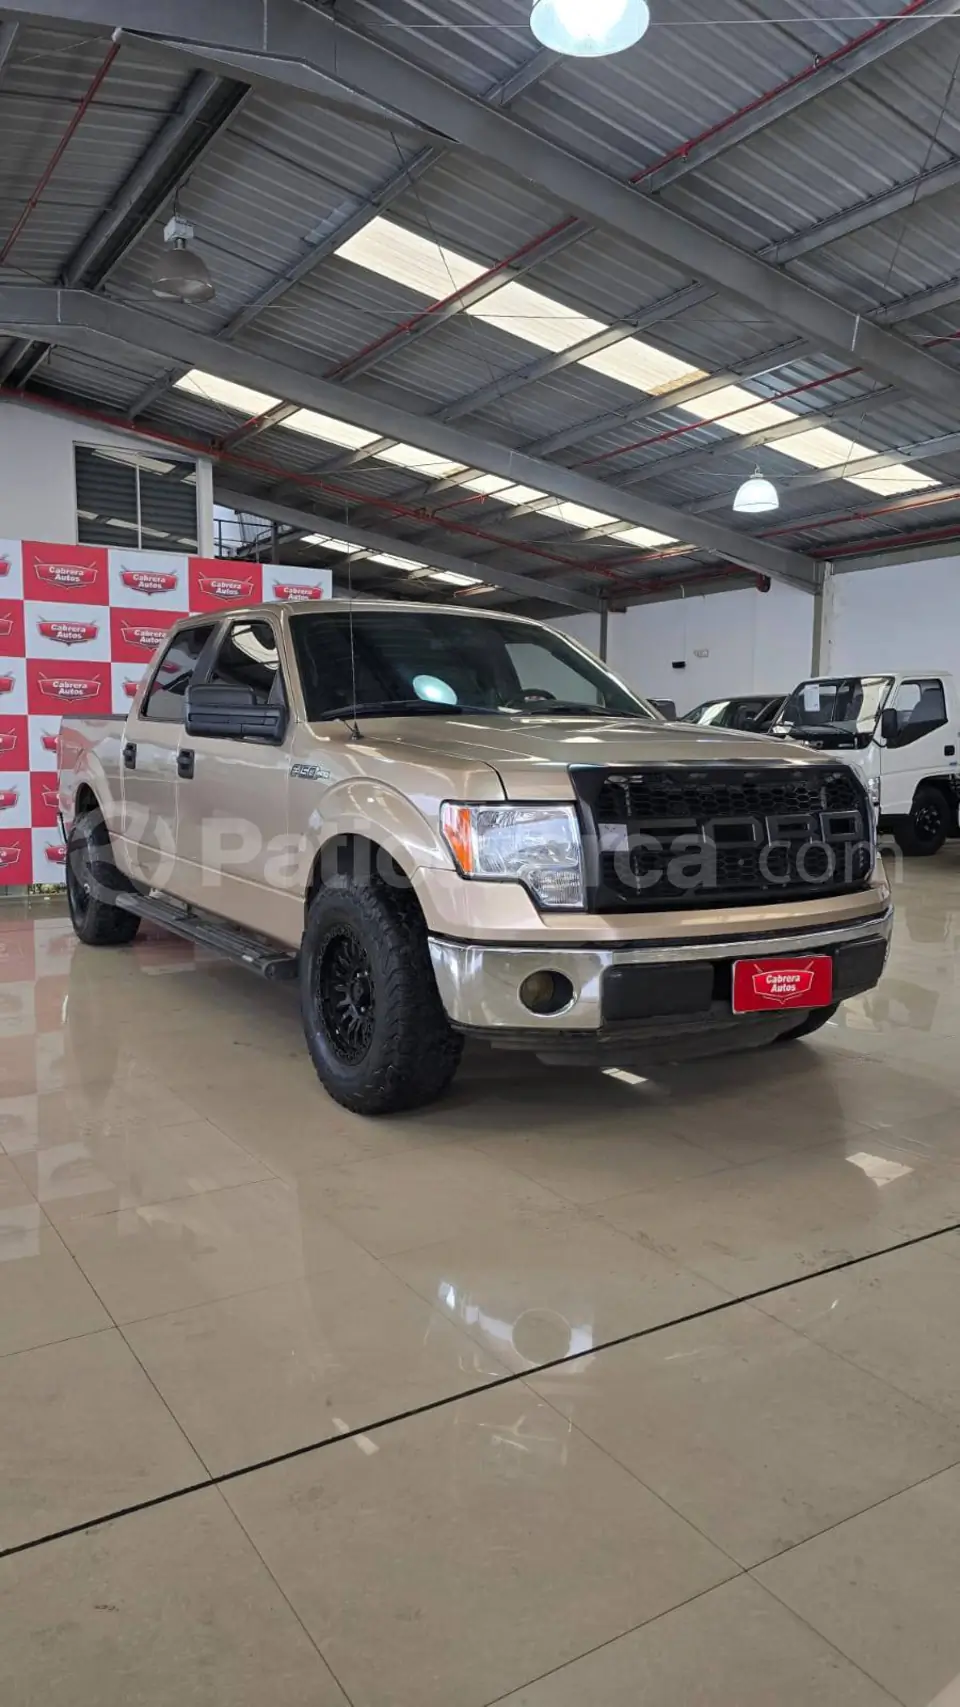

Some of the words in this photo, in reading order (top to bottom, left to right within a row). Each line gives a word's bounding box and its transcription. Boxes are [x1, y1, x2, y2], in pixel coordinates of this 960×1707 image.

[49, 566, 85, 576] Cabrera
[54, 574, 81, 583] Autos
[132, 573, 166, 583] Cabrera
[138, 581, 163, 589] Autos
[211, 580, 242, 590] Cabrera
[51, 623, 86, 633] Cabrera
[56, 631, 82, 639] Autos
[52, 681, 88, 690] Cabrera
[58, 687, 84, 695] Autos
[766, 974, 801, 985] Cabrera
[771, 984, 797, 993] Autos
